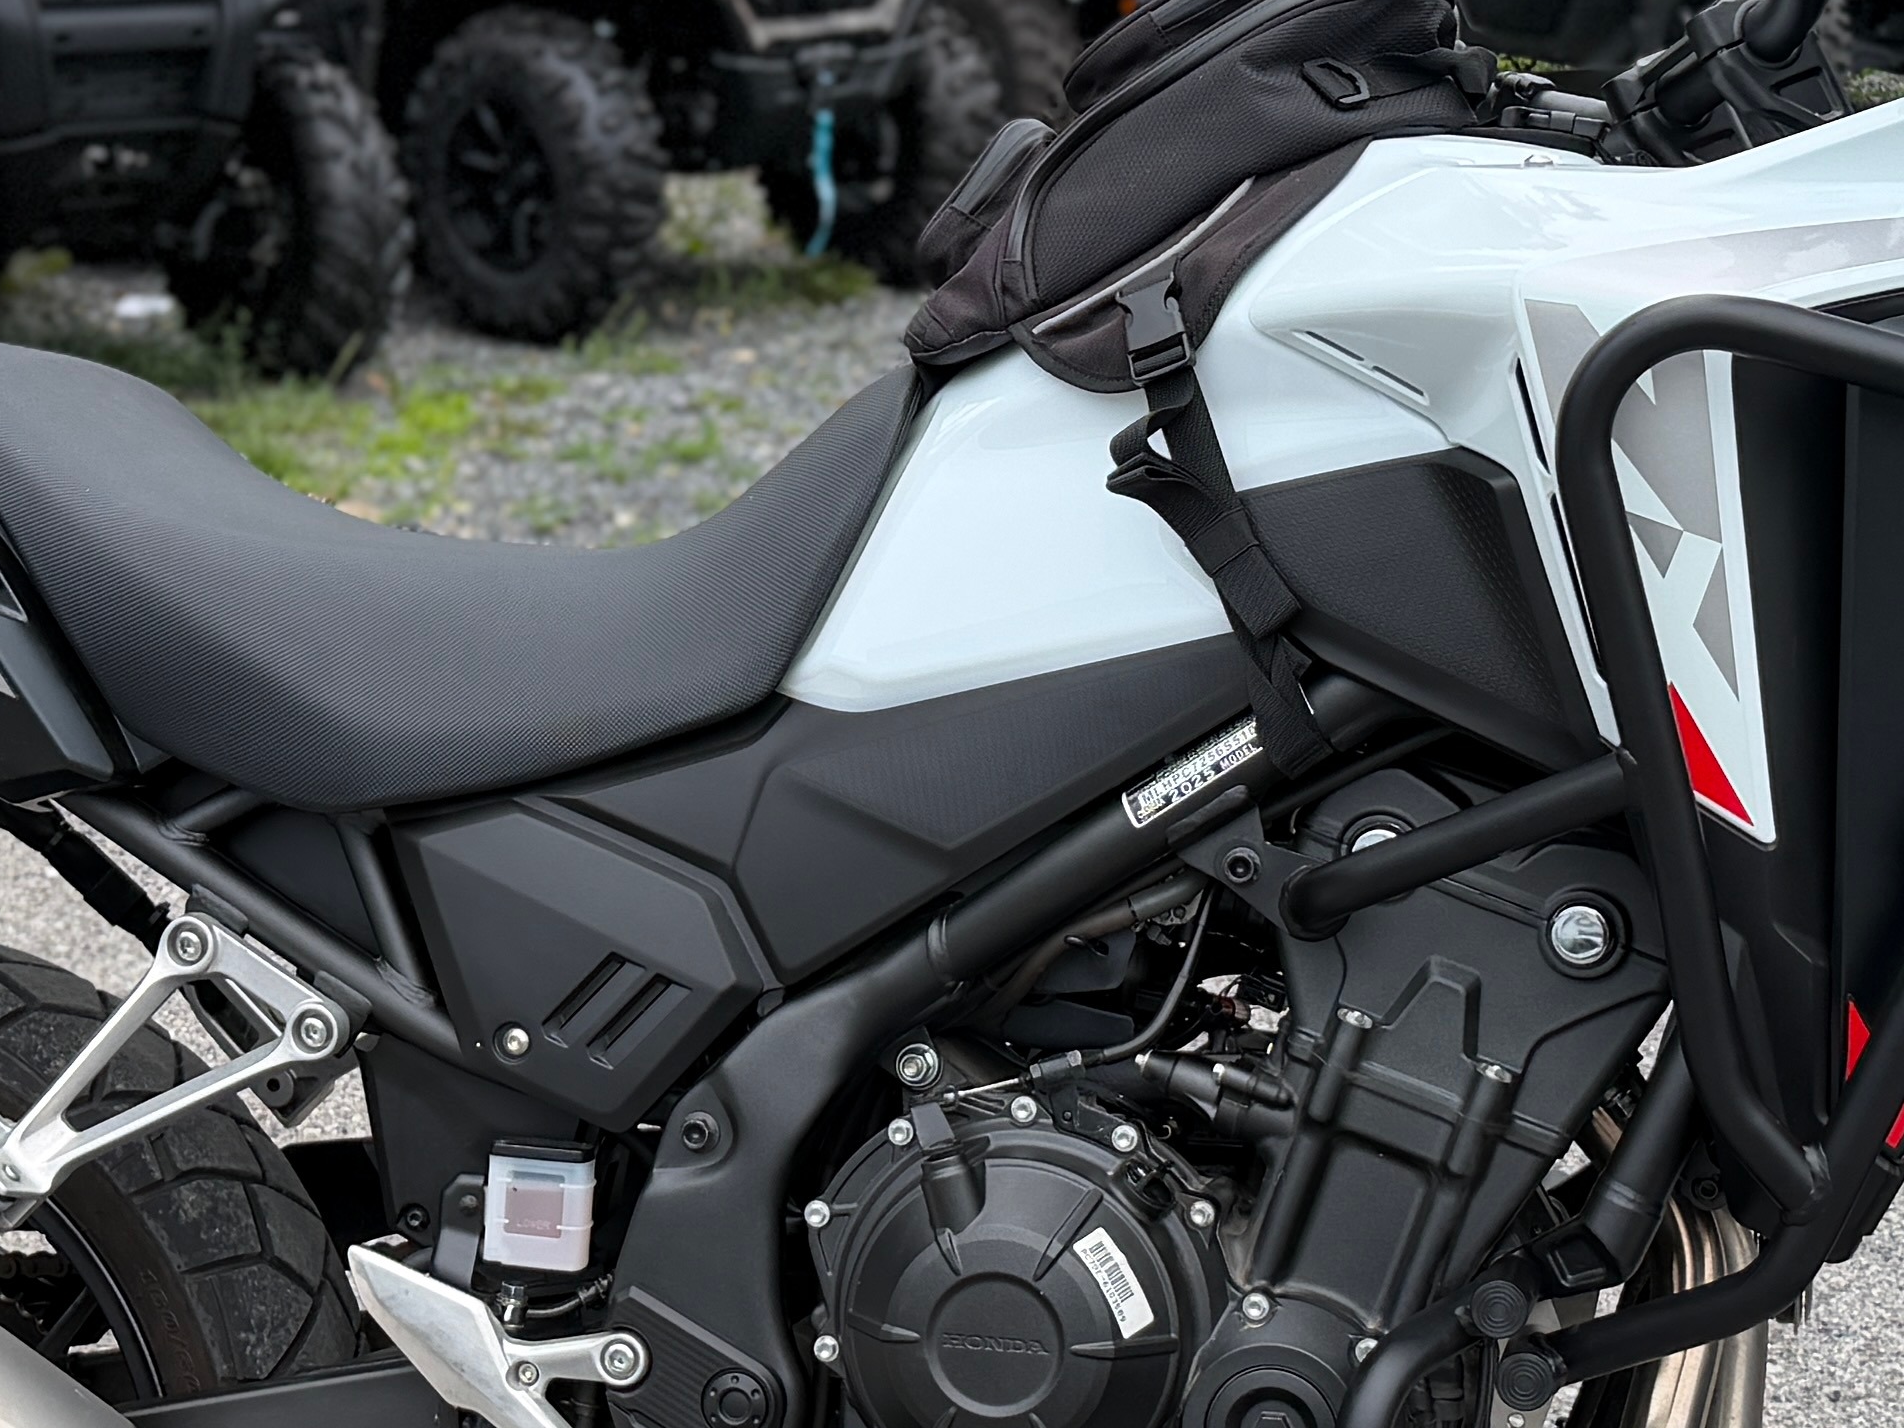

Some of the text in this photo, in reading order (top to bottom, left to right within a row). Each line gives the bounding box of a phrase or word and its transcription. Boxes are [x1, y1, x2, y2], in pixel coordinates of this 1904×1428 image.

[1168, 742, 1257, 804] 2025 MODEL
[941, 1332, 1050, 1356] HONDA
